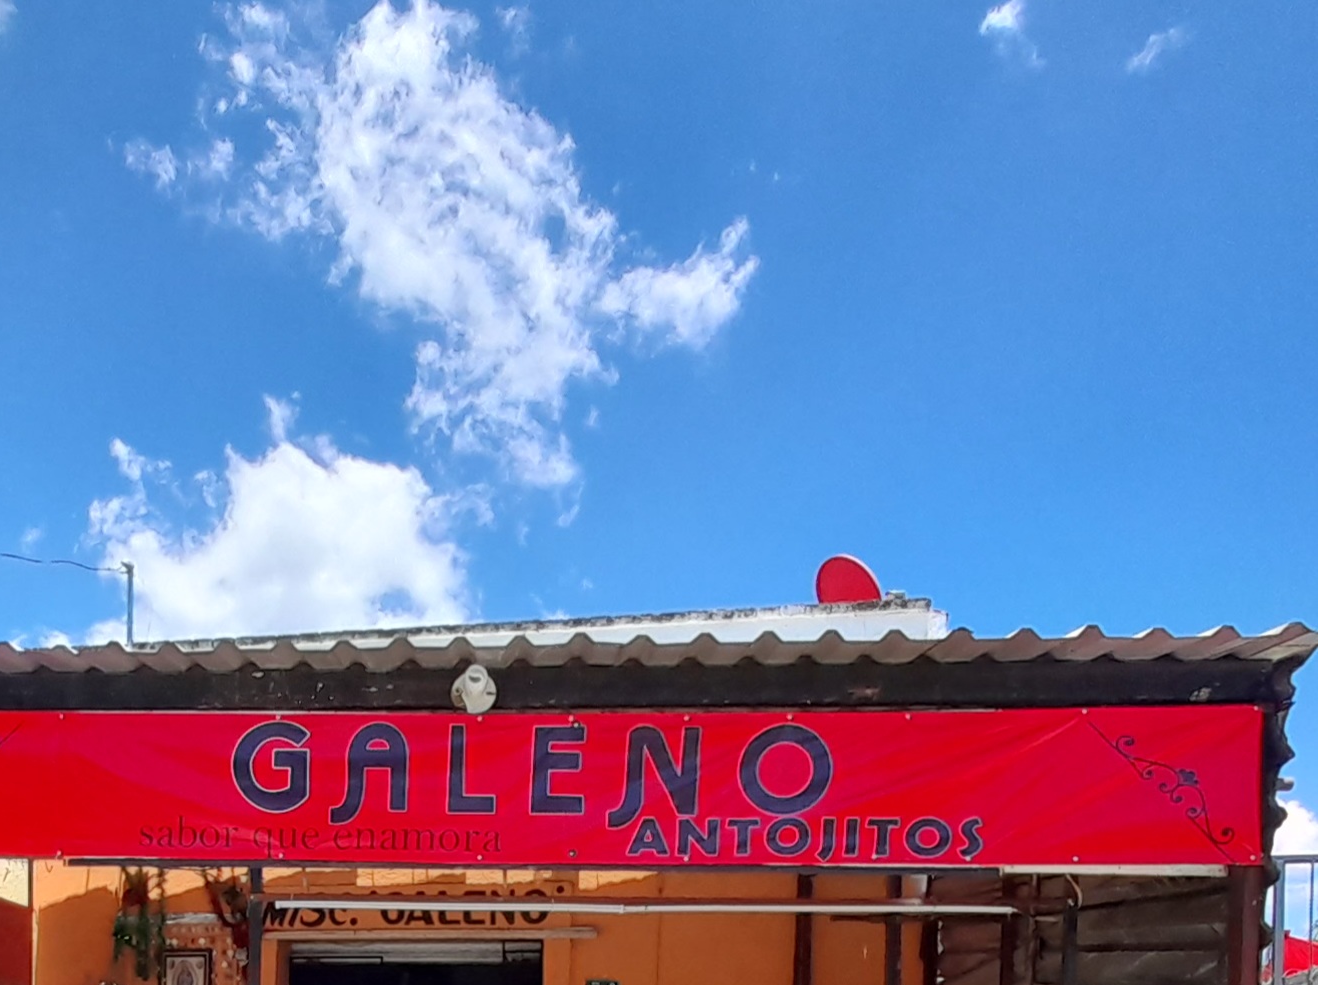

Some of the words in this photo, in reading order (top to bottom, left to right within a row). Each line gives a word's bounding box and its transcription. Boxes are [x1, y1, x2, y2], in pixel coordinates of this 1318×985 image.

[232, 720, 833, 829] GALENO
[138, 816, 239, 849] sabor
[253, 825, 320, 859] que
[332, 825, 502, 852] enamora
[626, 815, 984, 861] ANTOJITOS
